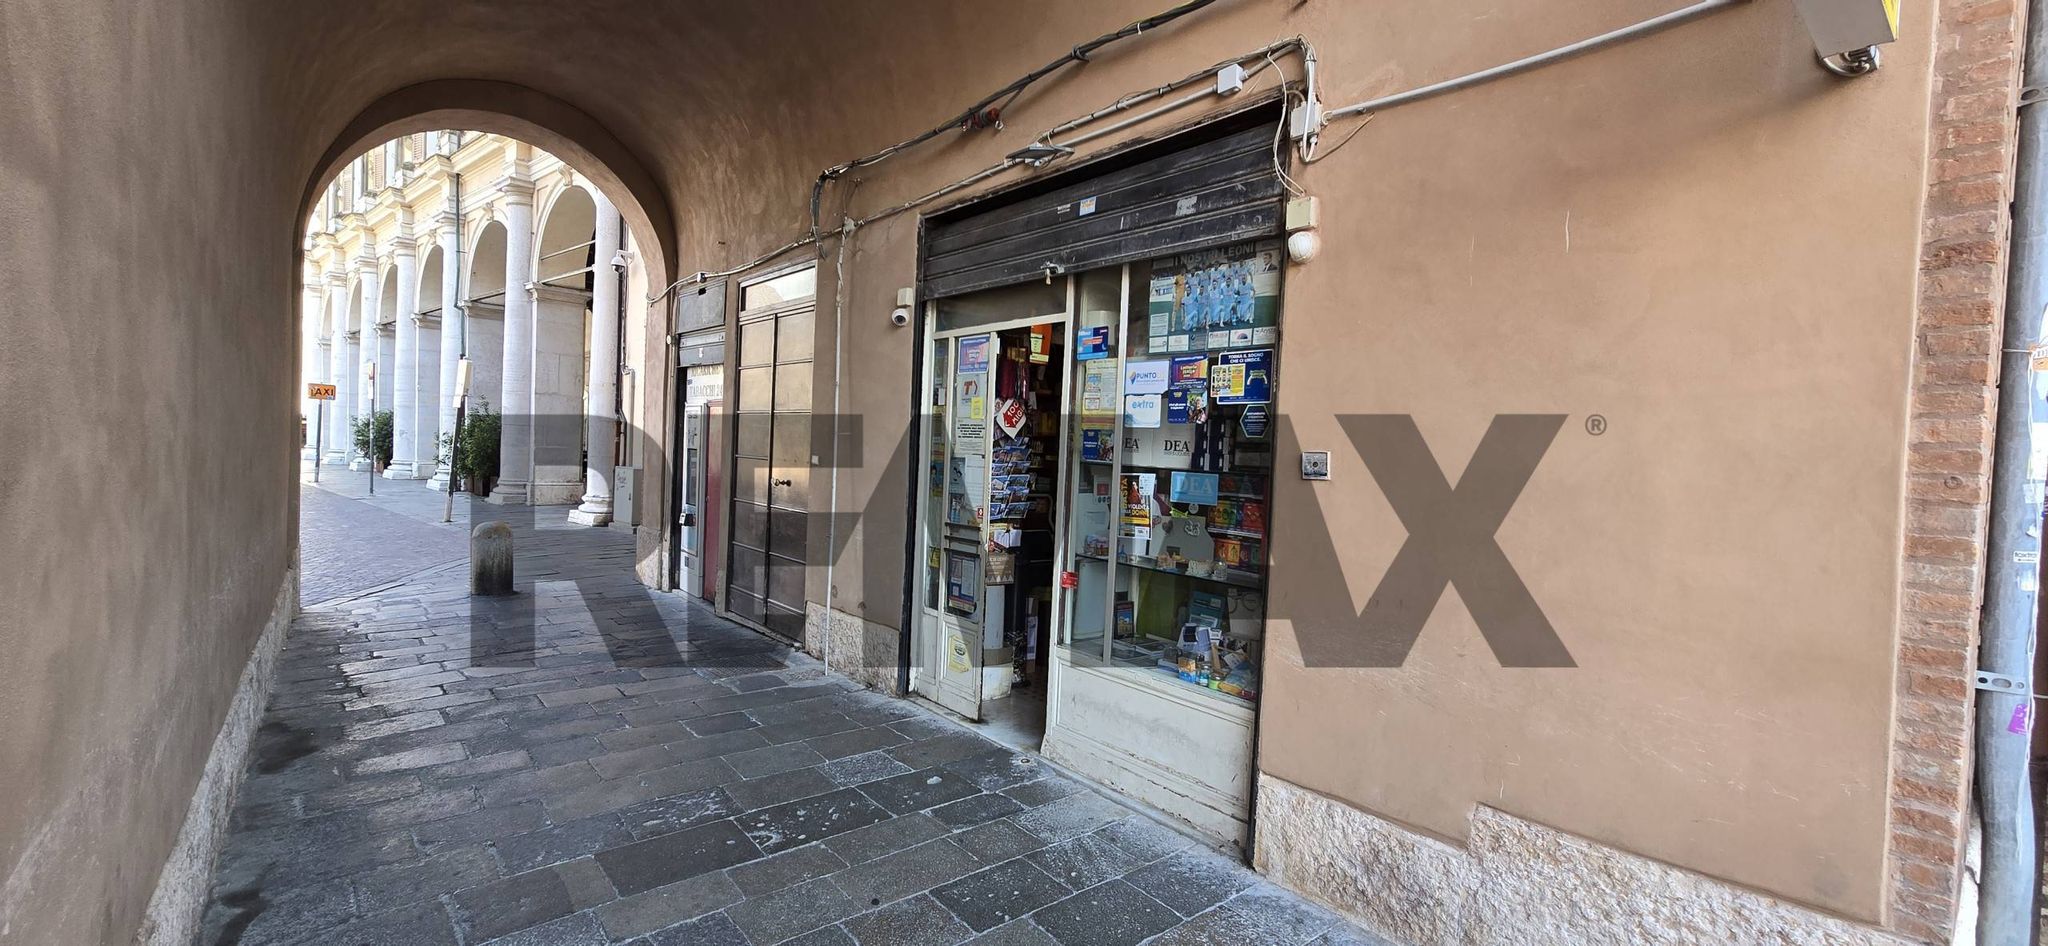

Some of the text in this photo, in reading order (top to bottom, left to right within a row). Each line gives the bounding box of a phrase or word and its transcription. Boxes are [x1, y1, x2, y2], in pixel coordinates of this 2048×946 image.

[1221, 242, 1254, 258] LEONI
[1136, 372, 1157, 380] PUNTO
[1132, 400, 1154, 409] extra
[1164, 440, 1188, 452] DEA
[1174, 474, 1213, 494] DEA
